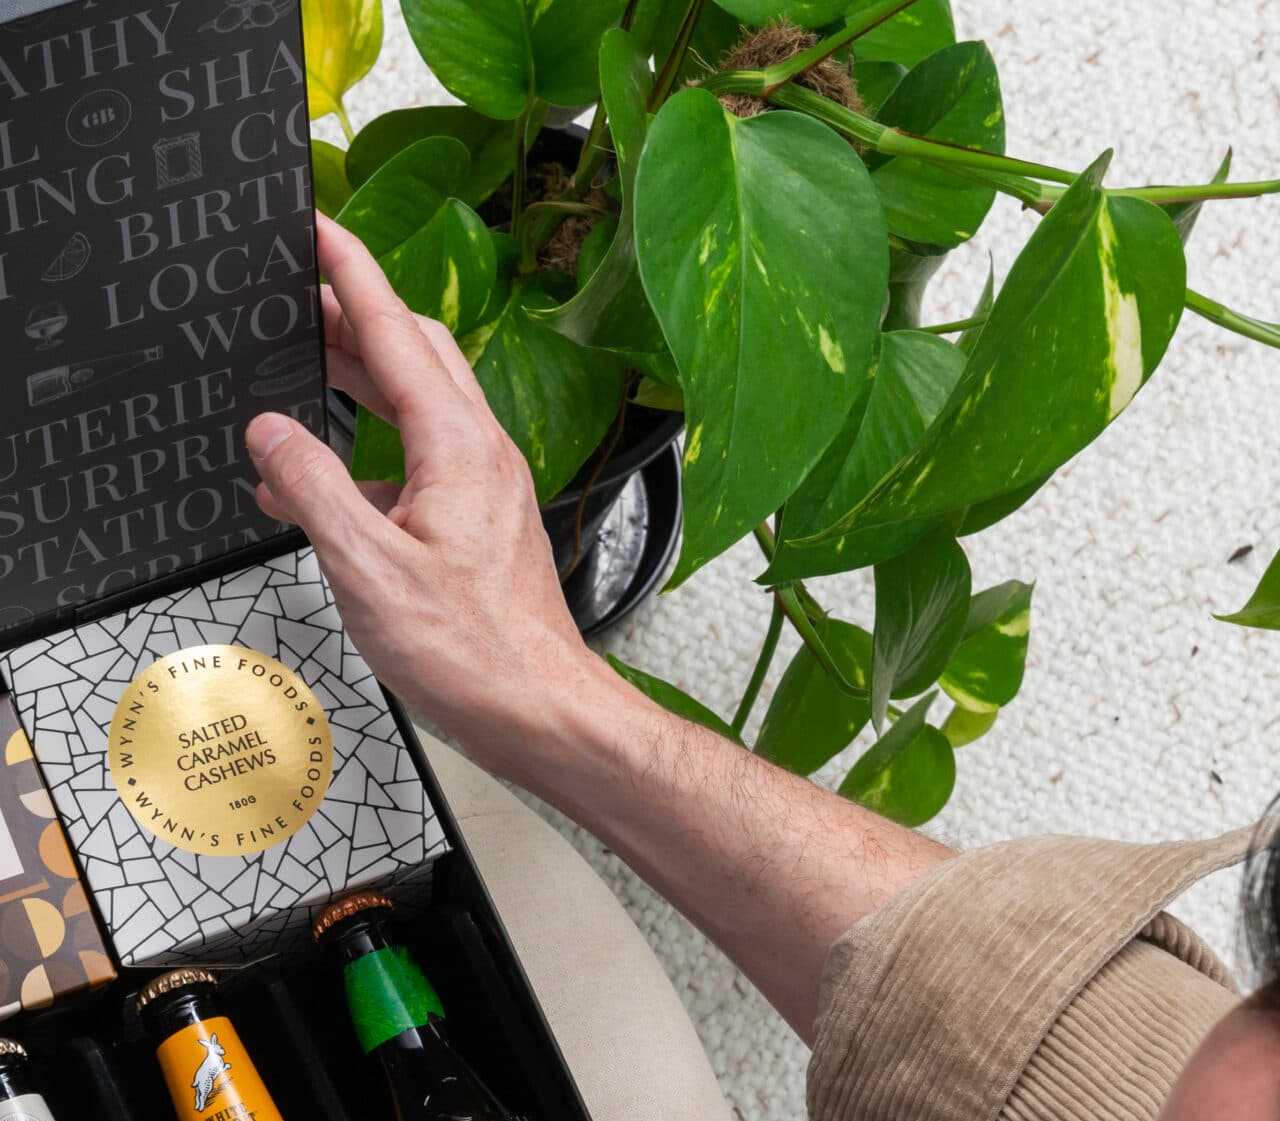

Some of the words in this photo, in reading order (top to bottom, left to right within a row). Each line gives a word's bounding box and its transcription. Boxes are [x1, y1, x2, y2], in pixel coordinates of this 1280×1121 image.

[119, 680, 160, 768] WYNN'S
[167, 655, 221, 680] FINE
[237, 658, 309, 713] FOODS
[178, 713, 248, 749] SALTED
[176, 730, 269, 772] CARAMEL
[183, 748, 277, 792] CASHEWS
[135, 791, 220, 848] WYNN'S
[236, 815, 289, 847] FINE
[292, 735, 324, 812] FOODS
[228, 794, 258, 812] 180G
